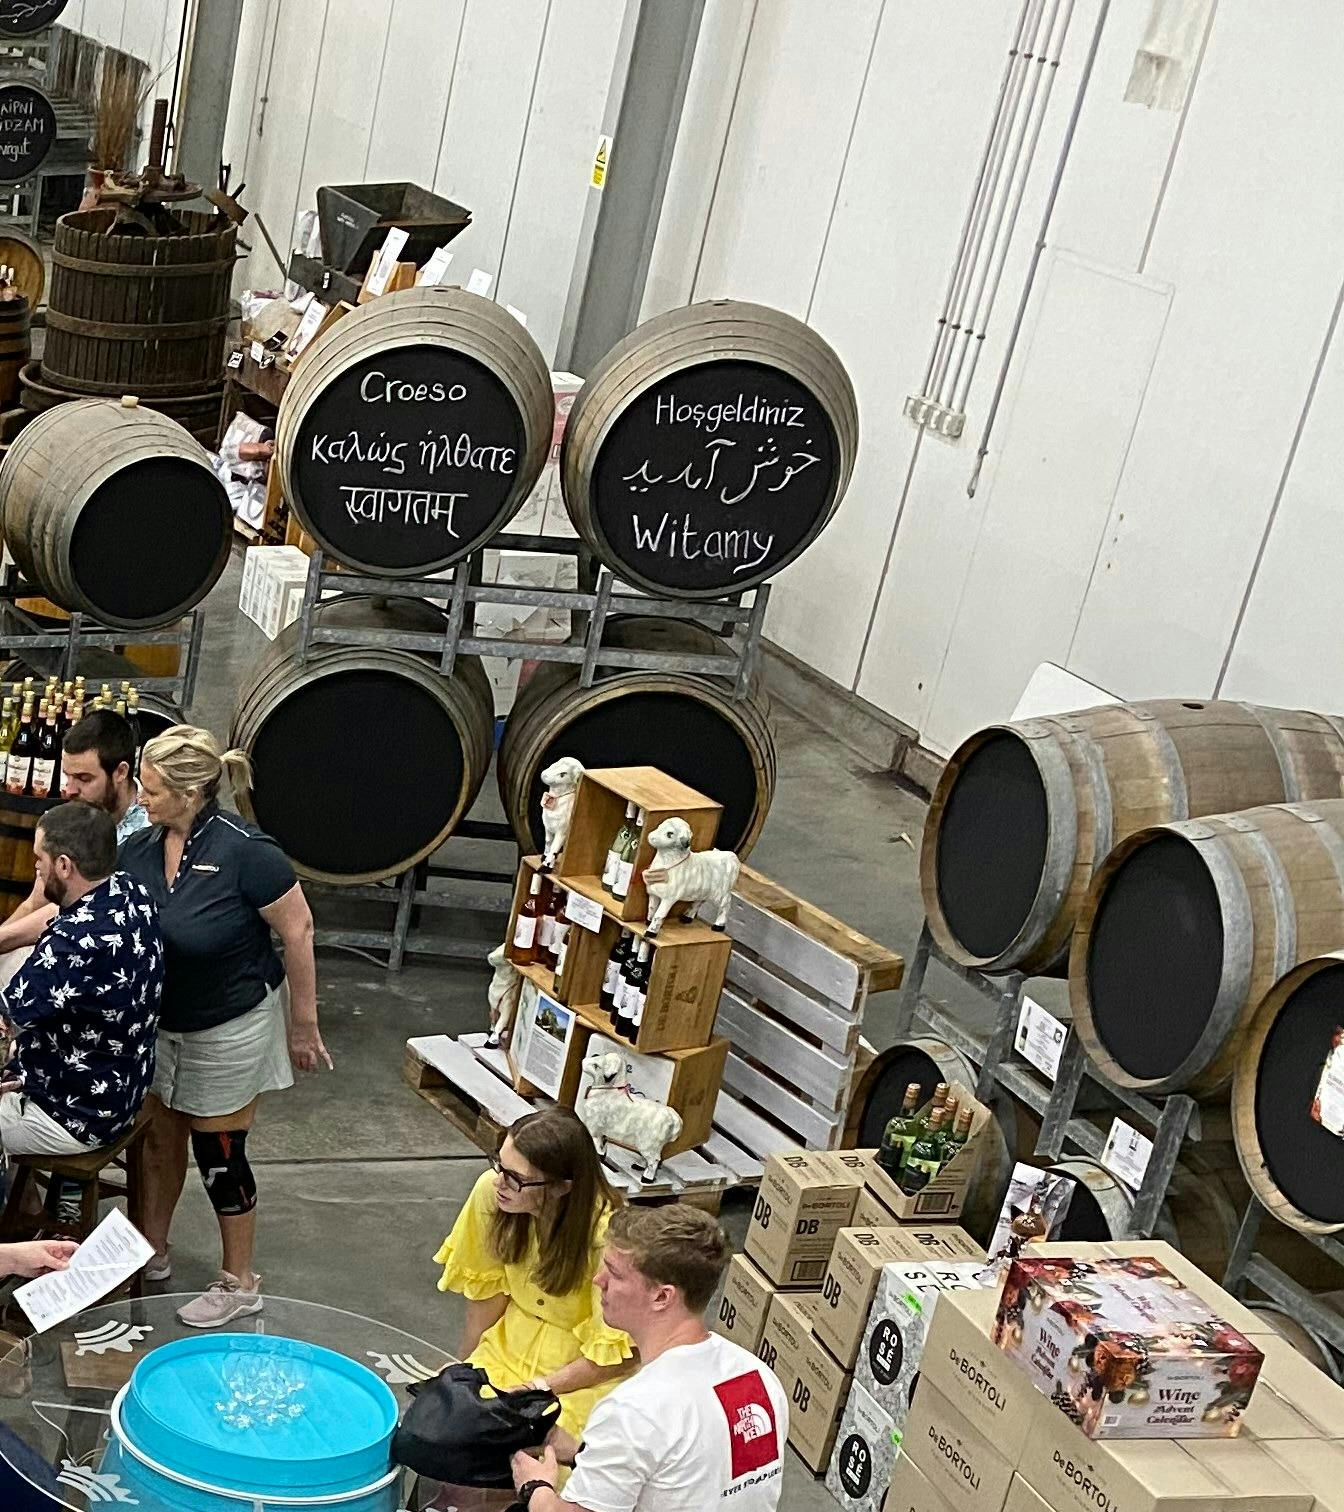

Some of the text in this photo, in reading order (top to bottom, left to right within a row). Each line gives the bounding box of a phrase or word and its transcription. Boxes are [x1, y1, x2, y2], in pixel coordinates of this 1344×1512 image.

[360, 371, 467, 403] Croeso
[655, 393, 805, 432] Hoşgeldiniz
[631, 513, 775, 574] Witamy
[754, 1195, 772, 1230] DB
[796, 1219, 820, 1235] DB
[823, 1273, 842, 1309] DB
[1039, 1327, 1061, 1358] Wine
[793, 1378, 811, 1412] DB
[960, 1358, 1007, 1412] BORTOLI
[1159, 1389, 1201, 1405] Wine
[1146, 1414, 1195, 1426] Calendar
[1153, 1404, 1195, 1414] Advent
[939, 1436, 982, 1491] BORTOLI
